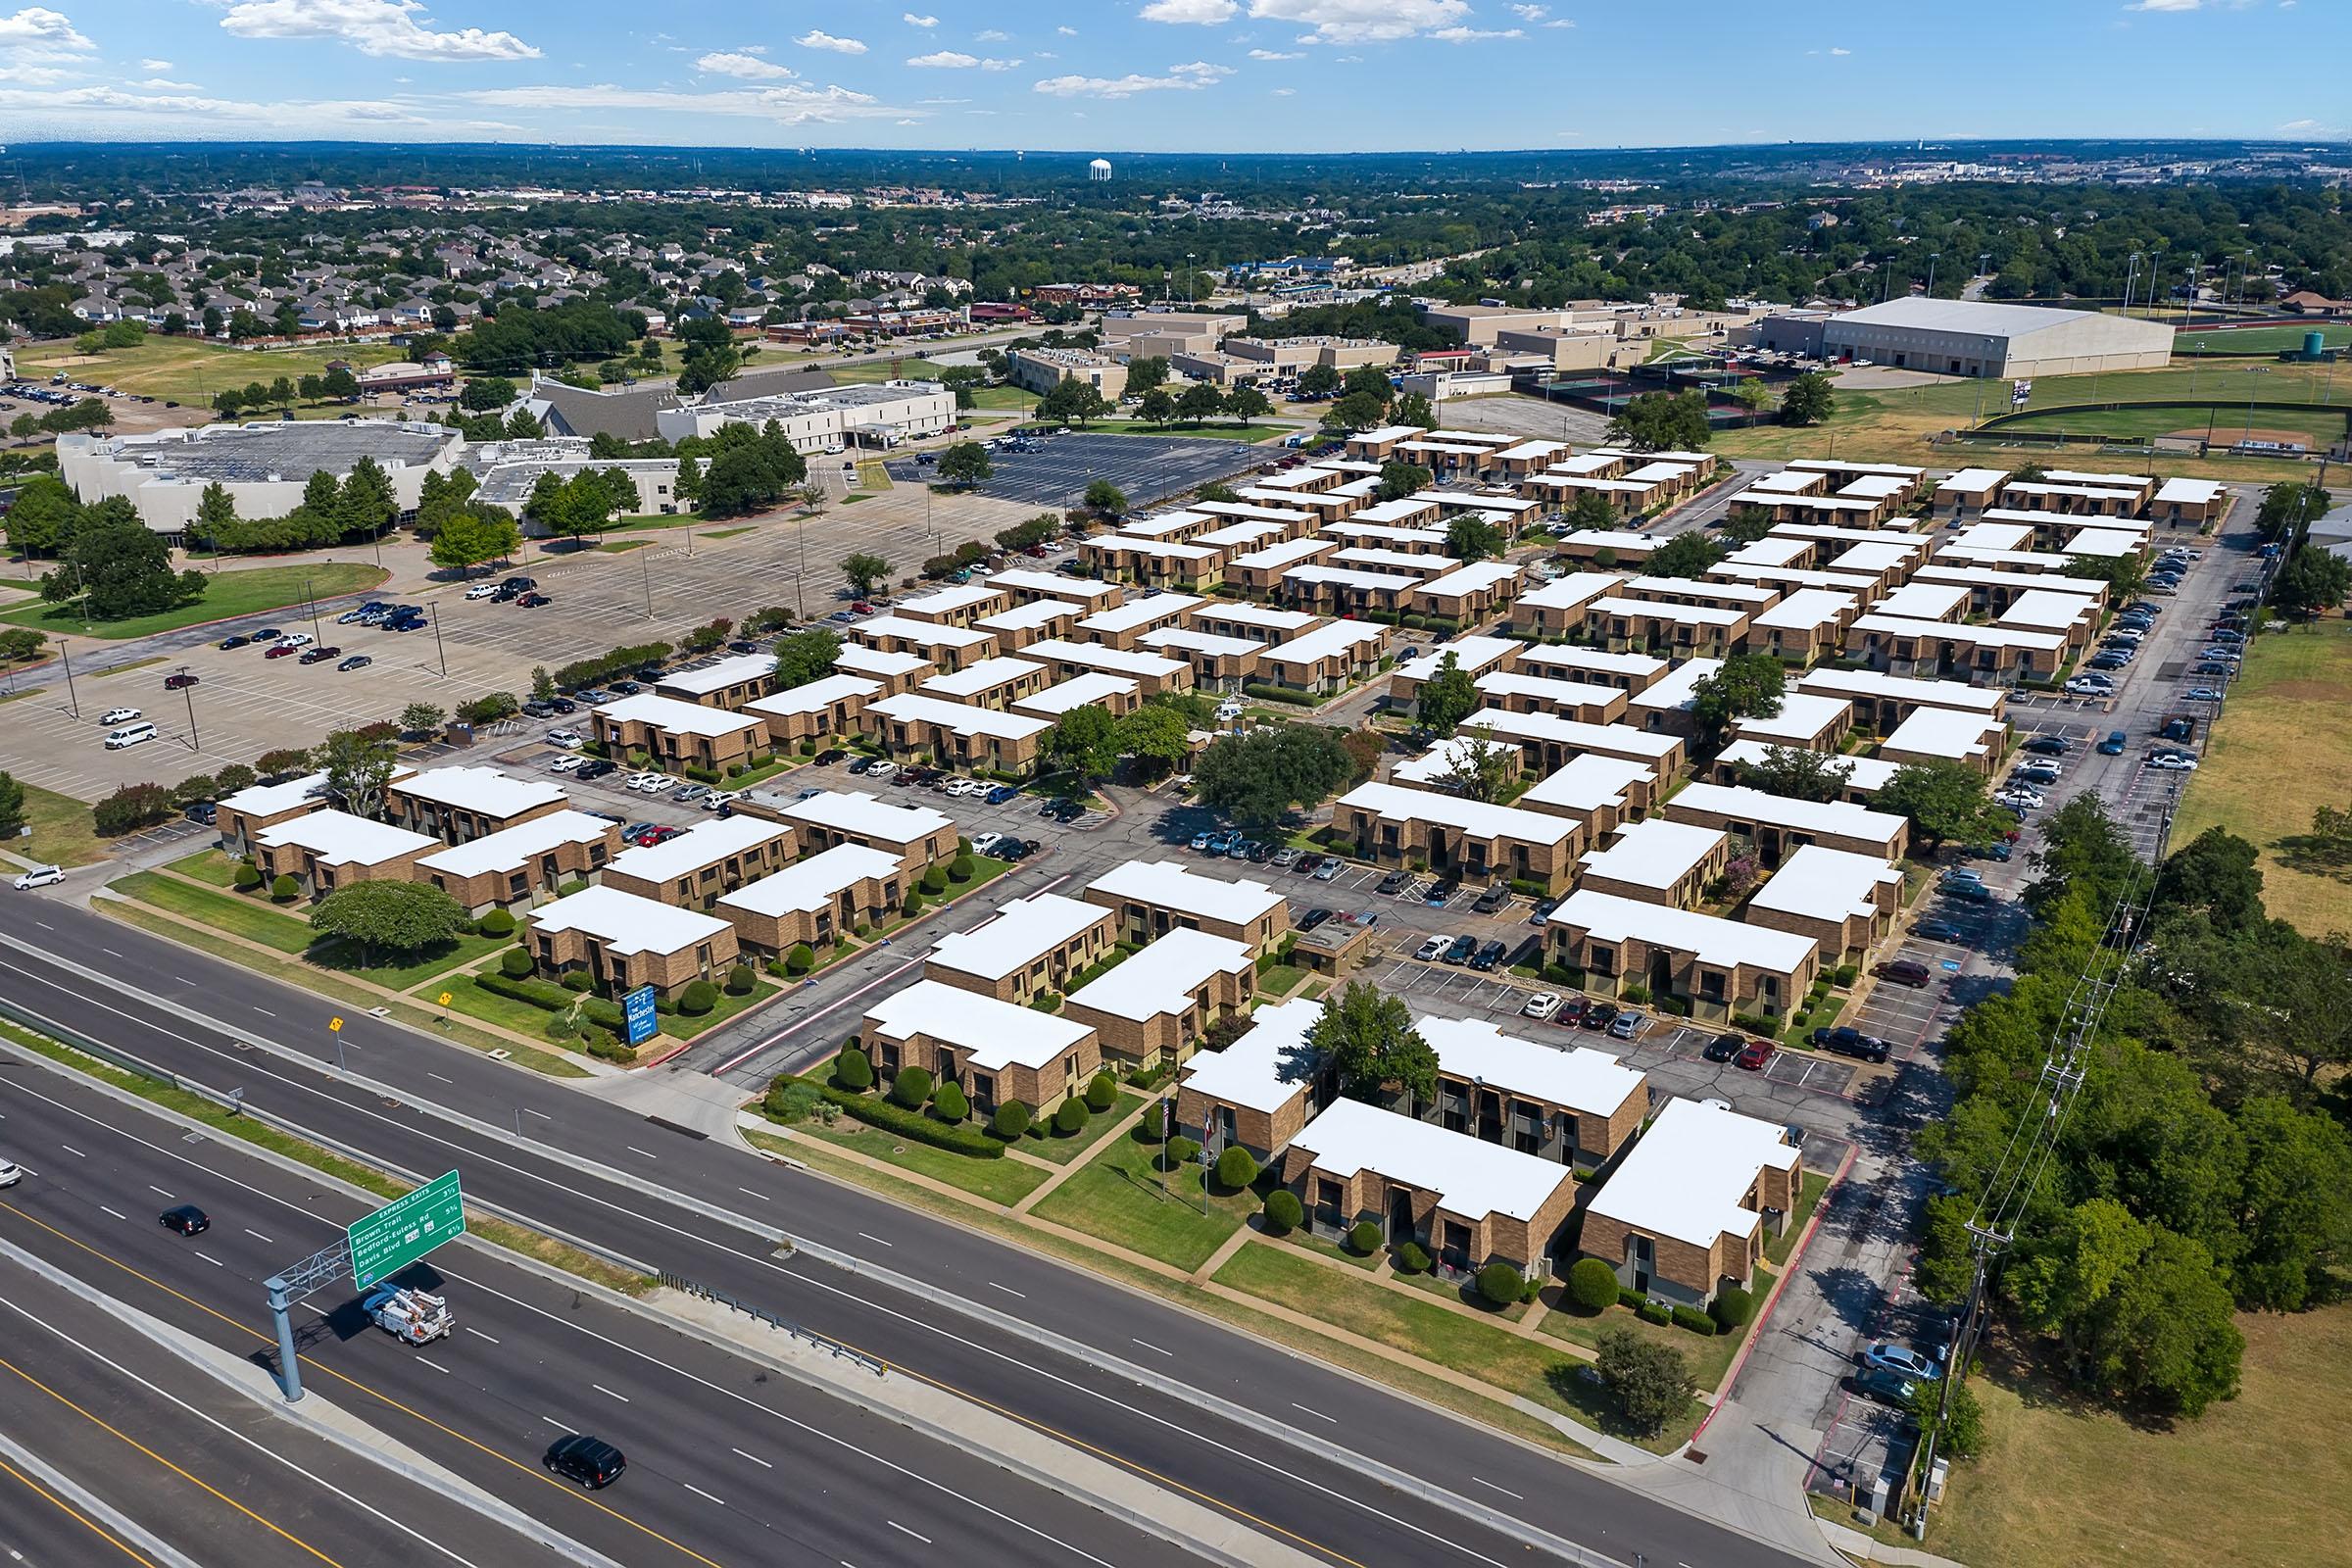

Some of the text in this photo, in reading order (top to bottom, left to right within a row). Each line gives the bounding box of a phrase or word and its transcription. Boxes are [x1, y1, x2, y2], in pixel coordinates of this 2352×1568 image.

[628, 1004, 655, 1023] Manchester
[378, 1188, 430, 1219] EXPRESS EXITS
[355, 1215, 402, 1246] Brown Trail
[357, 1212, 430, 1257] Bedford-Euless Rd
[359, 1240, 401, 1269] Davis Blvd
